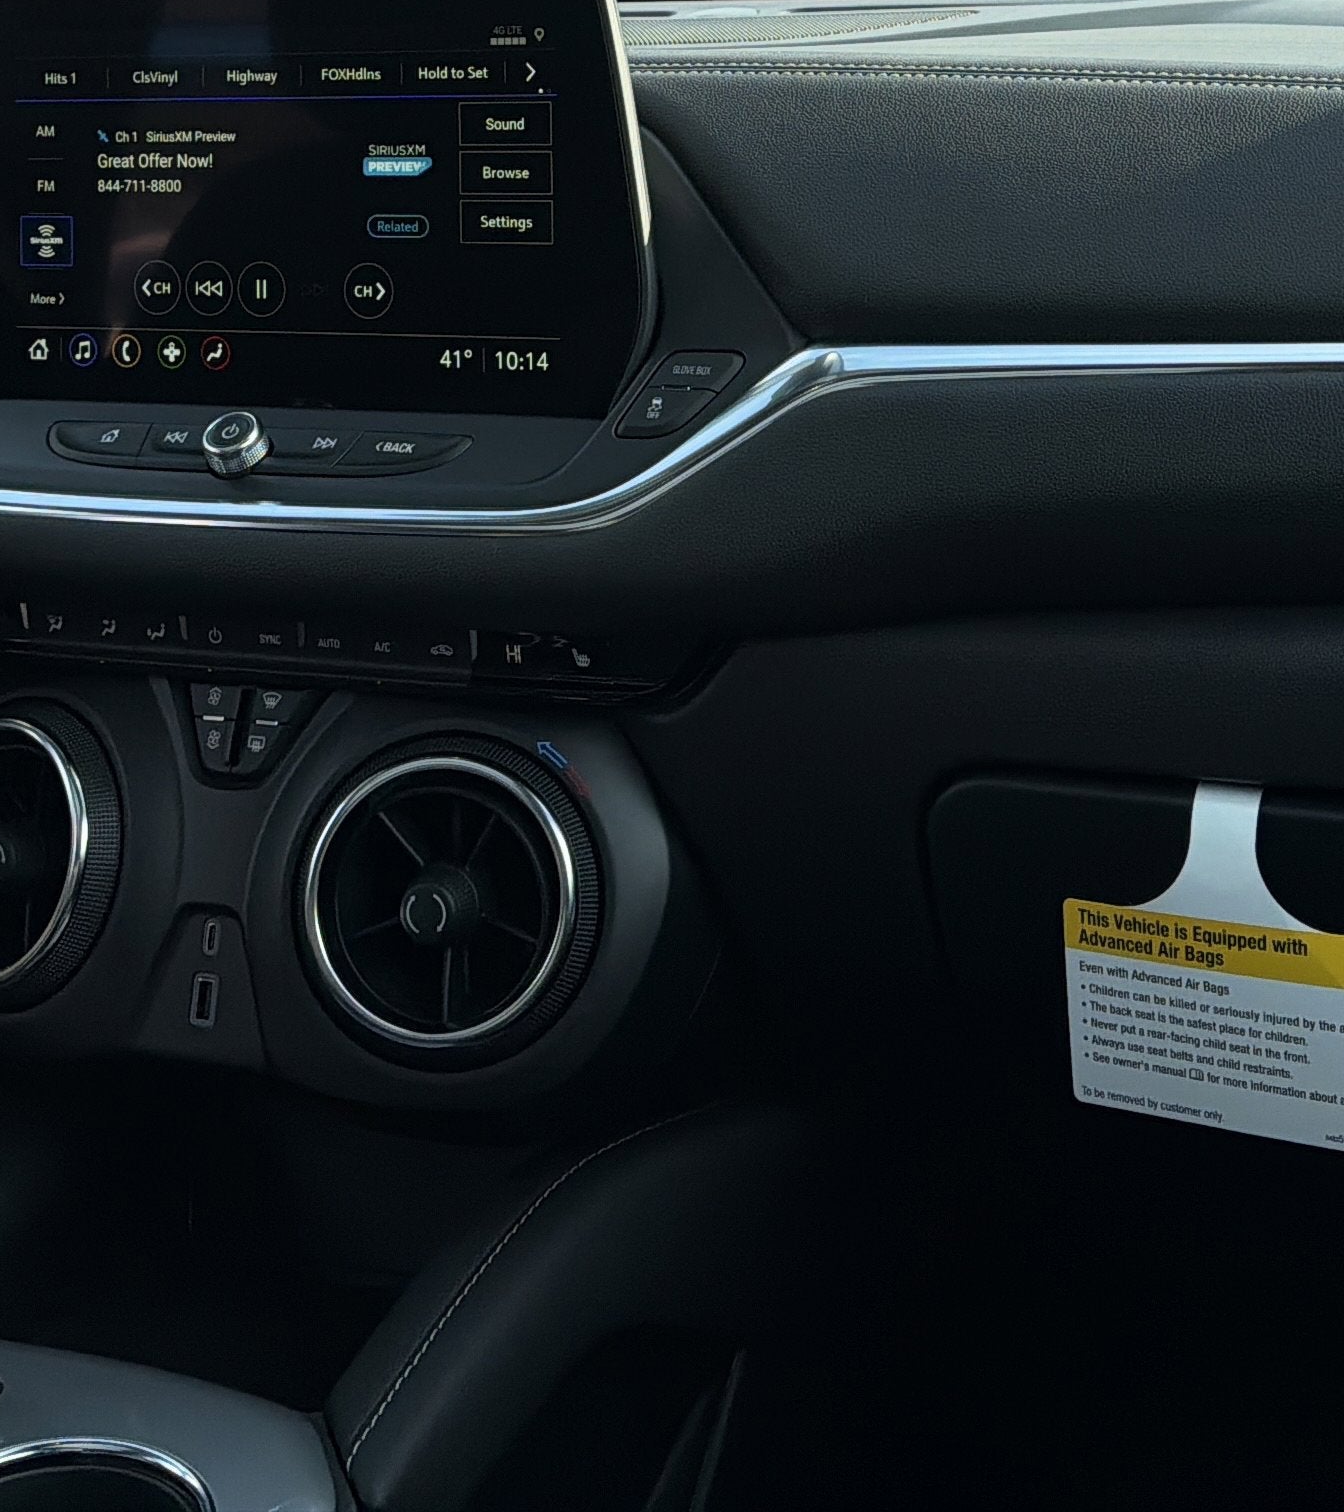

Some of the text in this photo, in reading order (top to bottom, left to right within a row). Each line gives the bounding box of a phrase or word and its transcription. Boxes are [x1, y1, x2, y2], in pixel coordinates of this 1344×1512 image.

[493, 26, 522, 35] 4G LTE
[44, 72, 77, 85] Hits 1
[132, 70, 178, 87] ClsVinyl
[226, 69, 278, 86] Highway
[418, 66, 488, 79] Hold to Set
[485, 117, 525, 131] Sound
[35, 125, 55, 137] AM
[115, 131, 236, 142] Ch 1 SiriusXM Preview
[368, 144, 426, 156] SIRIUSXM
[97, 153, 213, 168] Great Offer Now!
[368, 160, 427, 173] PREVIEW
[482, 166, 530, 179] Browse
[37, 180, 55, 192] FM
[97, 180, 182, 193] 844-711-8800
[377, 220, 418, 233] Related
[480, 215, 533, 232] Settings
[154, 283, 171, 295] CH
[354, 285, 373, 298] CH
[30, 293, 56, 305] More
[439, 349, 473, 369] 41°
[494, 351, 549, 371] 10:14
[672, 365, 712, 378] GLOVE BOX
[382, 441, 415, 454] BACK
[258, 633, 282, 645] SYNC
[317, 638, 341, 649] AUTO
[373, 641, 392, 653] A/C
[505, 646, 523, 664] HI
[1078, 908, 1307, 956] This Vehicle is Equipped with
[1079, 929, 1224, 967] Advanced Air Bags
[1080, 960, 1229, 996] Even with Advanced Air Bags
[1089, 984, 1129, 999] Children
[1133, 992, 1150, 1002] can
[1154, 993, 1166, 1005] be
[1169, 997, 1196, 1010] killed
[1213, 1005, 1259, 1022] seriously
[1263, 1012, 1299, 1027] injured
[1303, 1018, 1315, 1032] by
[1319, 1021, 1336, 1032] the
[1090, 1001, 1308, 1046] The back seat is the safest place for children.
[1091, 1018, 1310, 1064] Never put a rear-facing child seat in the front.
[1092, 1035, 1293, 1079] Always use seat belts and child restraints.
[1093, 1051, 1110, 1064] See
[1113, 1055, 1150, 1071] owner's
[1152, 1063, 1186, 1077] manual
[1207, 1072, 1219, 1083] for
[1223, 1077, 1247, 1088] more
[1251, 1080, 1306, 1099] information
[1309, 1090, 1338, 1104] about
[1082, 1085, 1224, 1123] To be removed by customer only.
